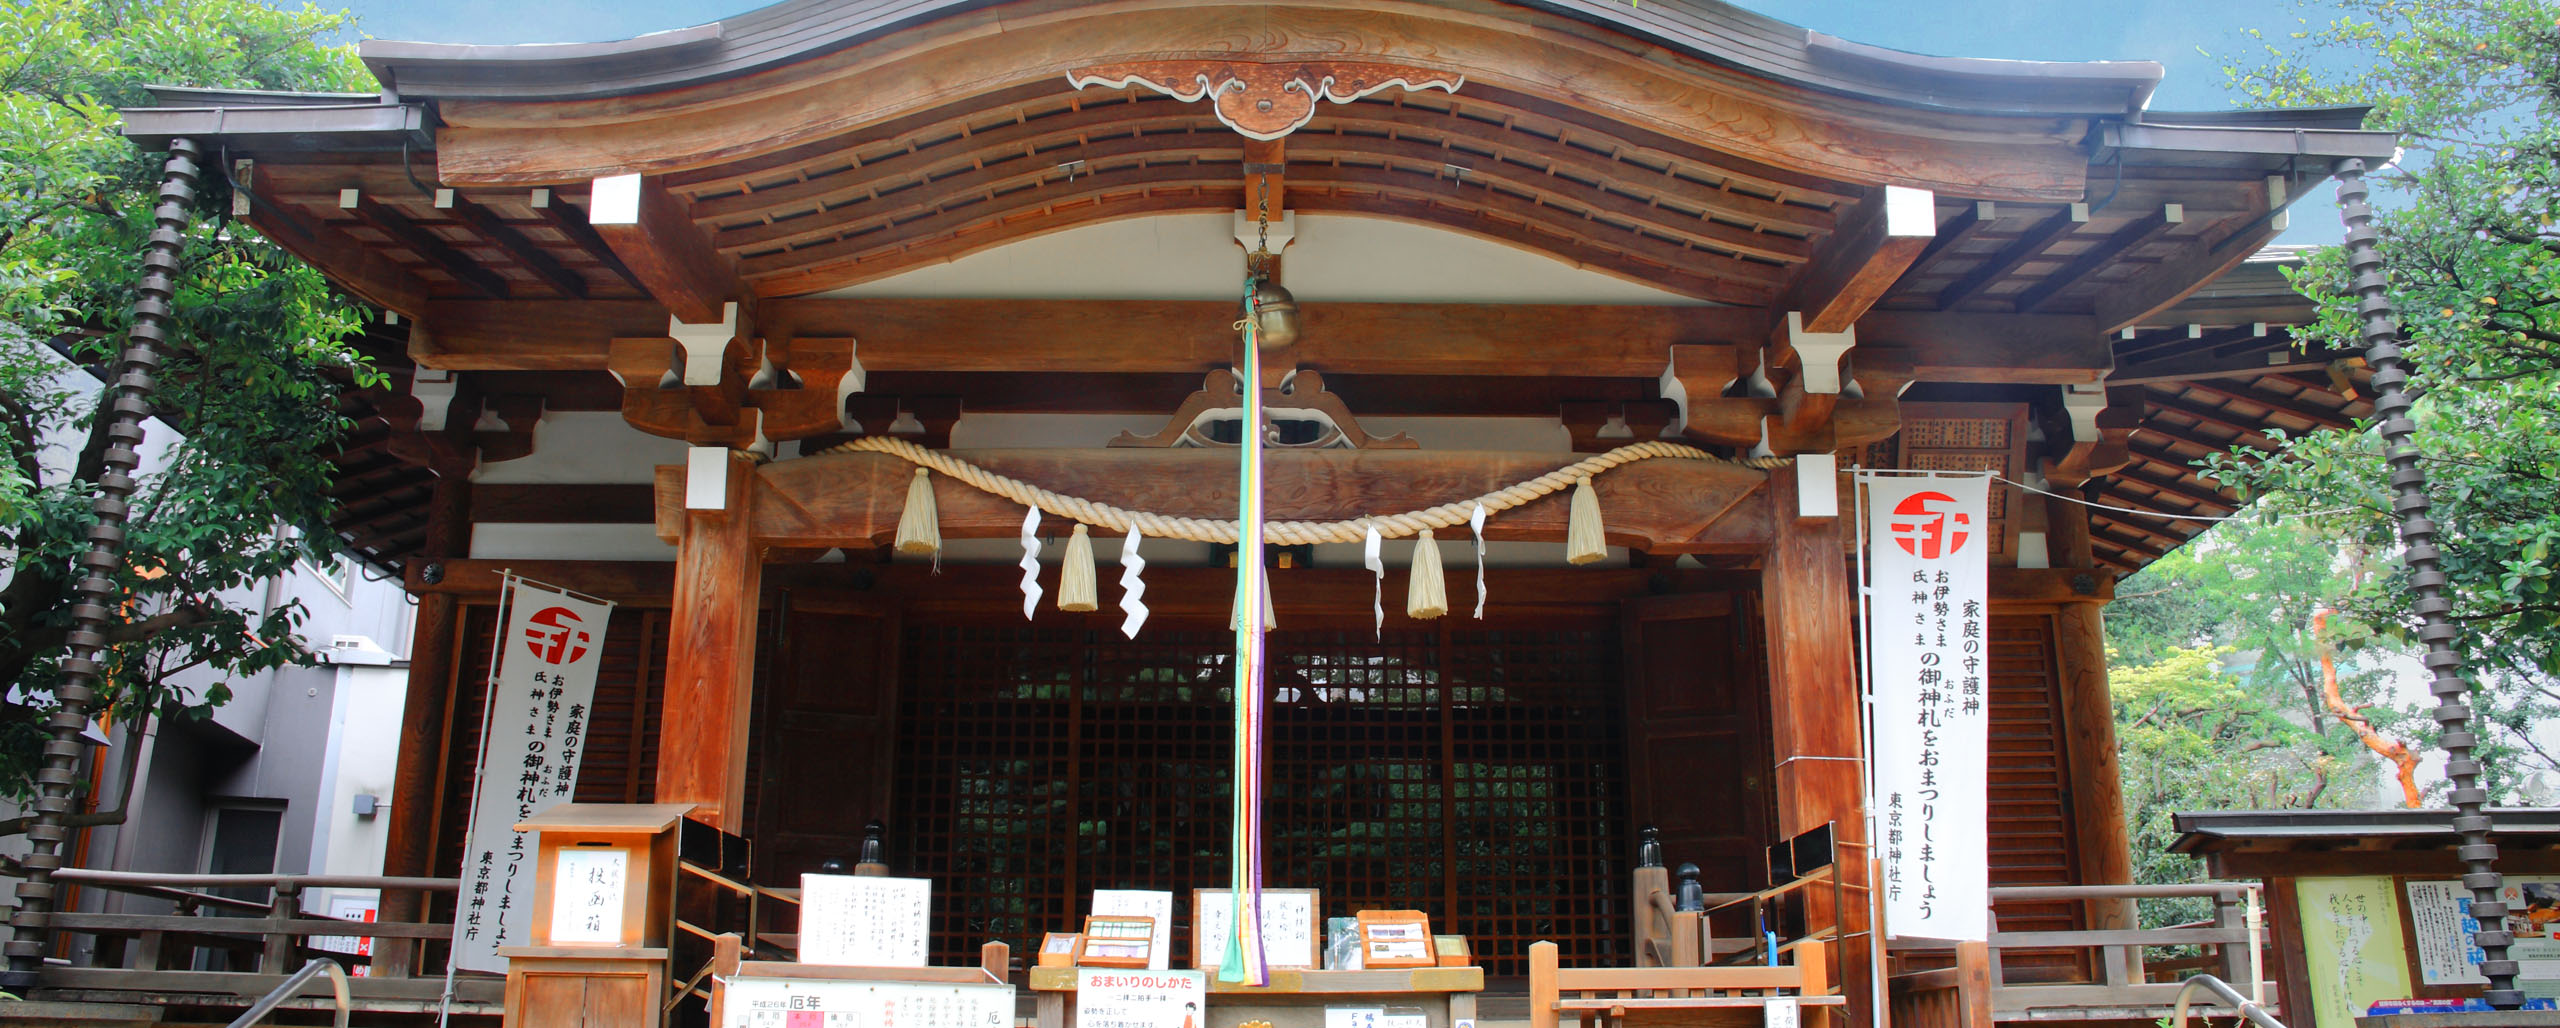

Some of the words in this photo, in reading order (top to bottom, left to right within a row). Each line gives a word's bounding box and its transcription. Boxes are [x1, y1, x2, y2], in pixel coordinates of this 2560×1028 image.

[1911, 570, 1928, 647] 氏神さま
[1933, 570, 1950, 649] お伊勢さま
[1962, 599, 1981, 716] 家庭の守護神
[525, 670, 548, 736] 氏神さま
[543, 674, 565, 739] お伊勢さま
[1943, 679, 1955, 719] おふだ
[537, 764, 552, 798] おふだ
[554, 703, 585, 798] 家庭の守護神
[1917, 652, 1942, 921] の御神札をおまつりしましょう
[1887, 792, 1903, 902] 東京都神社庁
[465, 850, 495, 941] 東京都神社庁
[585, 866, 606, 932] 投函箱
[789, 995, 821, 1010] 厄年
[1090, 975, 1193, 989] おまいりのしかた
